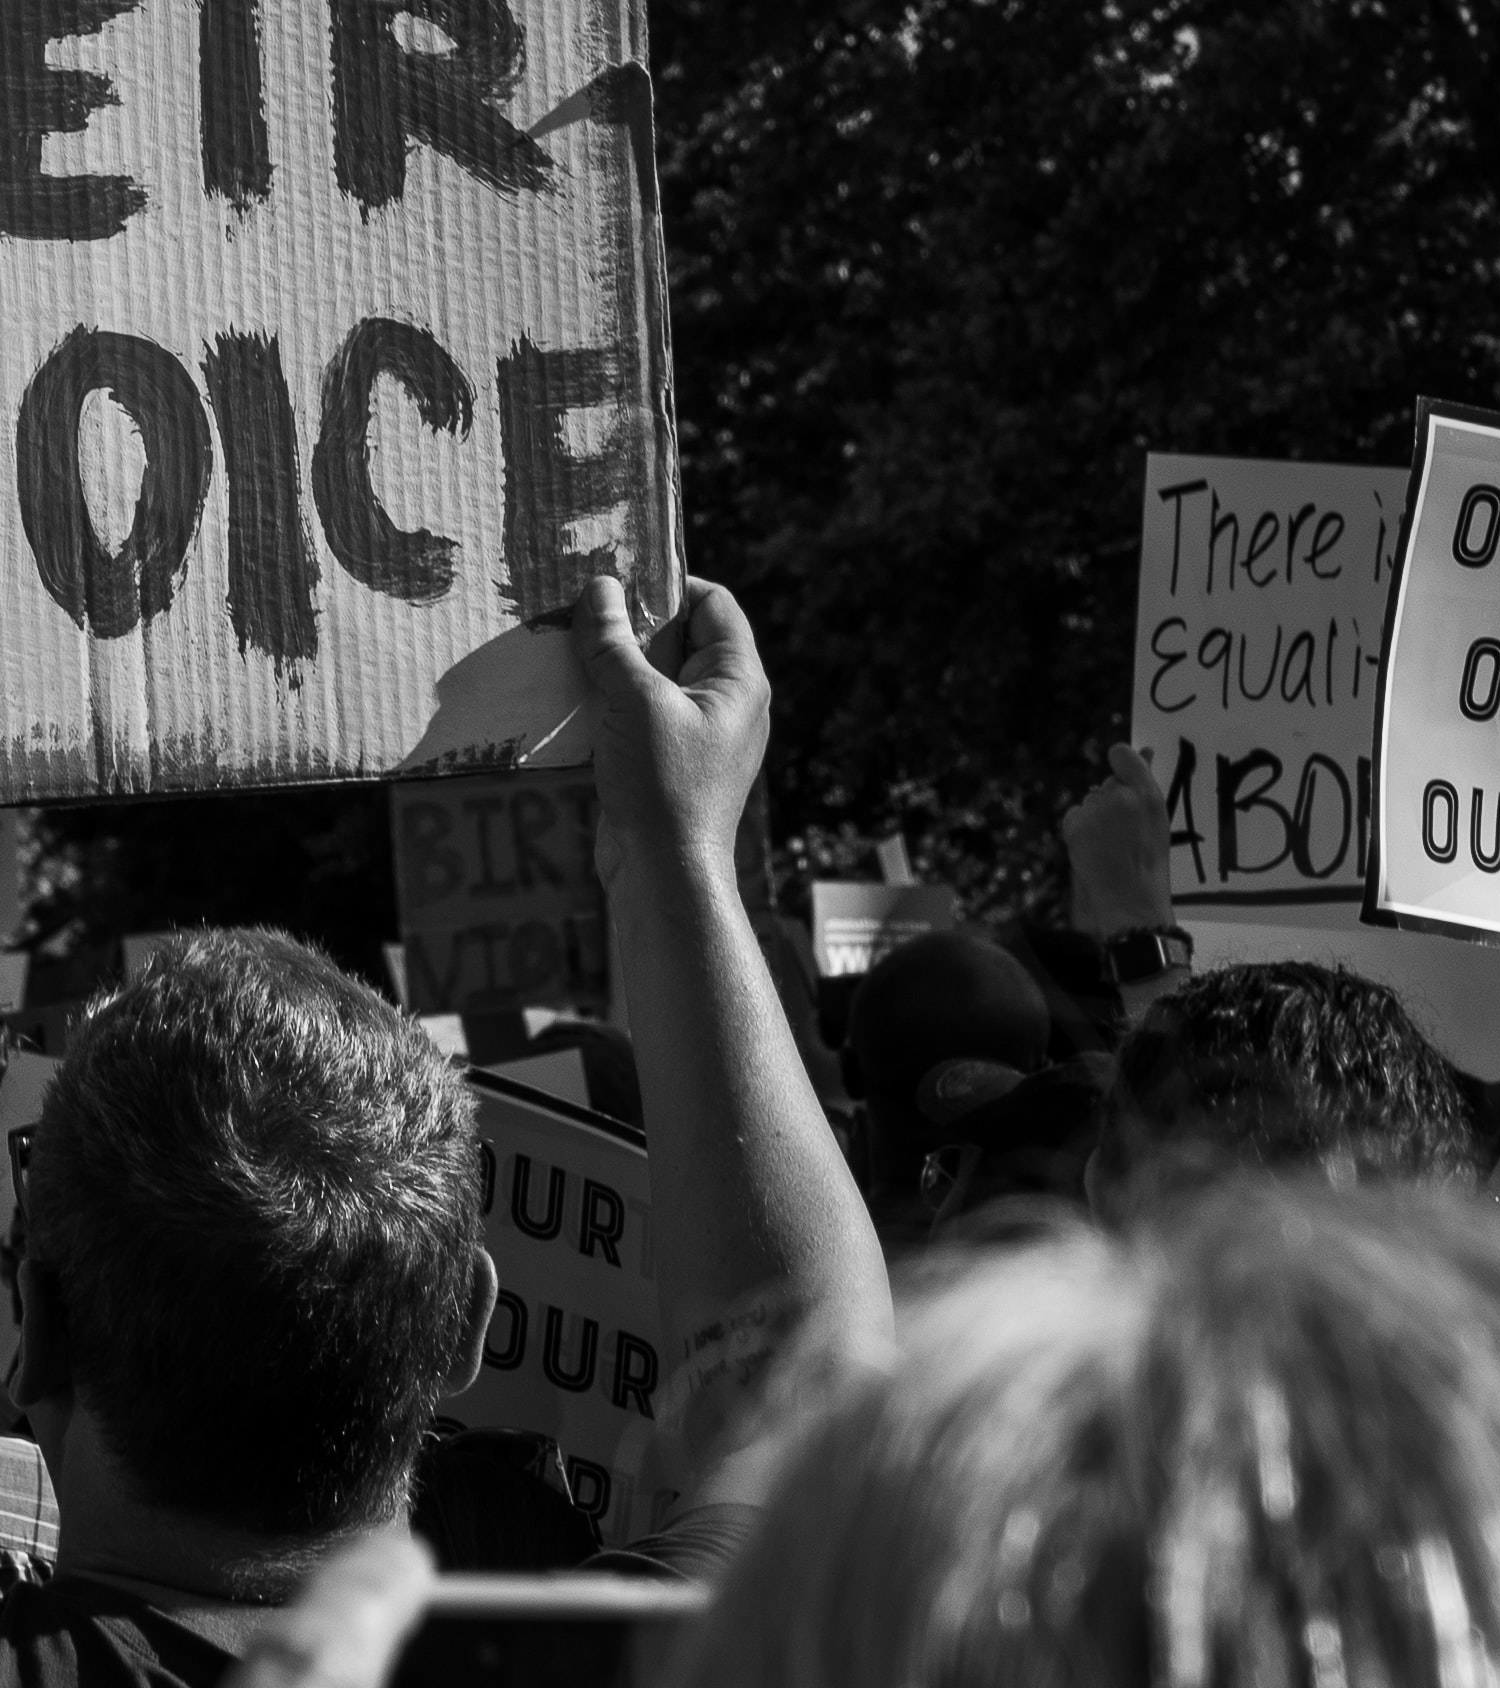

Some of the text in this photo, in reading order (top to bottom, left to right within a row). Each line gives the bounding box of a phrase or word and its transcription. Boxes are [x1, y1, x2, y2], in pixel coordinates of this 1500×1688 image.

[1158, 478, 1395, 596] There i
[1150, 616, 1379, 713] Equali
[483, 1288, 660, 1420] OUR
